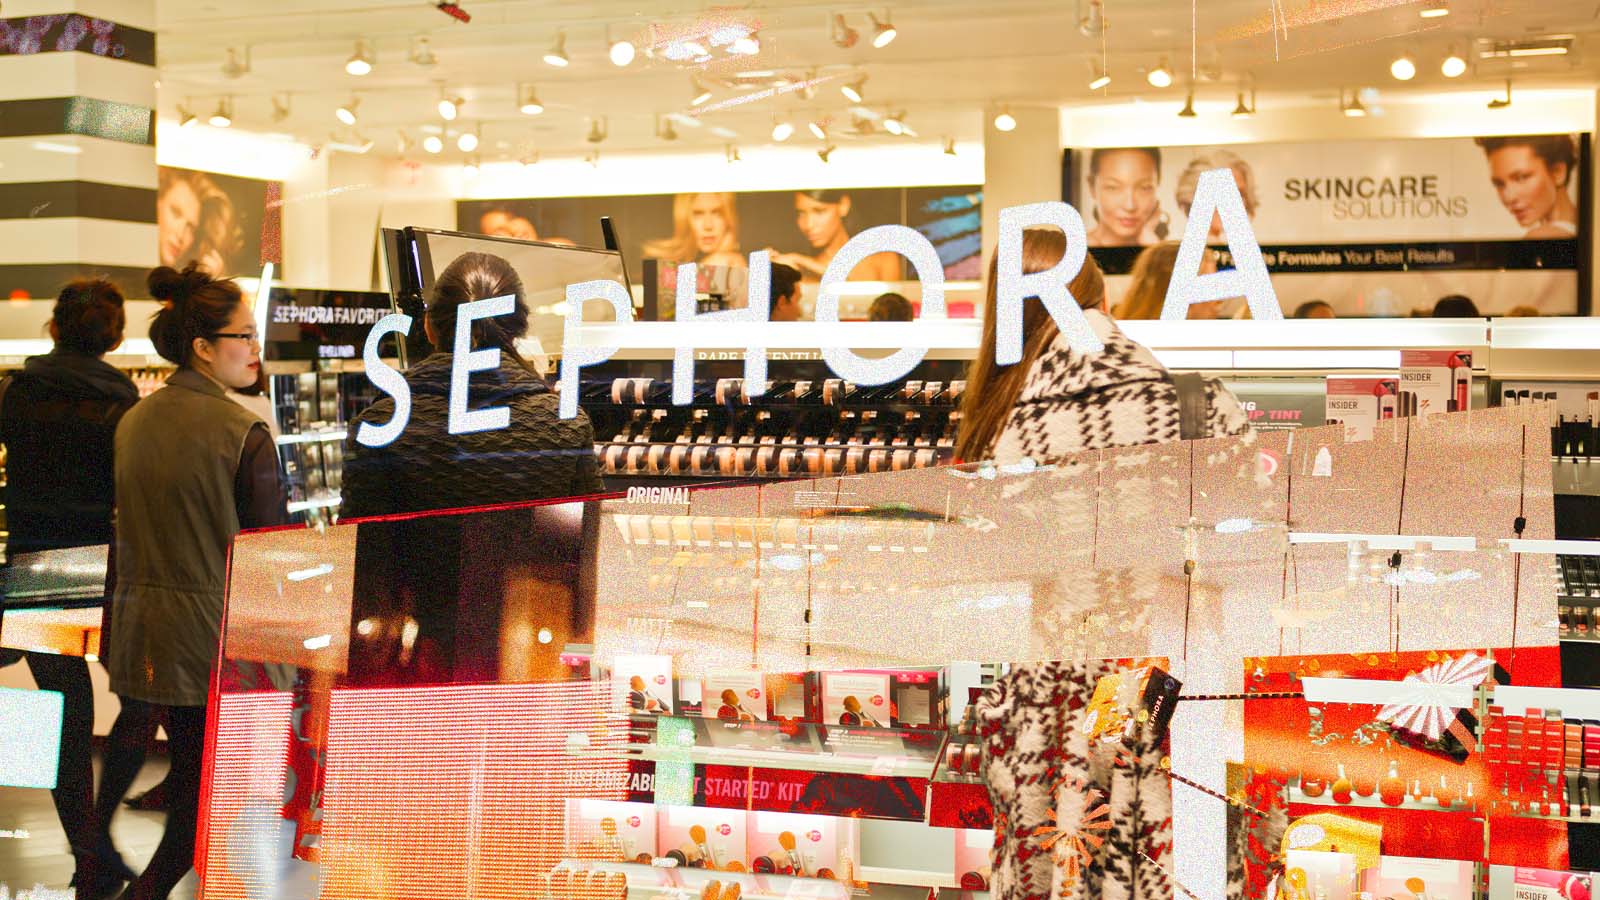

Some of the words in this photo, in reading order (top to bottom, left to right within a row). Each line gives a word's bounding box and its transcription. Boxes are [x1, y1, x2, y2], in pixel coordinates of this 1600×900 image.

[1284, 175, 1438, 200] SKINCARE
[1333, 197, 1469, 220] SOLUTIONS
[1278, 250, 1341, 266] Formulas
[1343, 249, 1372, 264] Your
[1375, 248, 1403, 264] Best
[1408, 247, 1455, 264] Results
[273, 305, 333, 324] SEPHORA
[355, 167, 1284, 449] SEPHORA
[1401, 373, 1432, 381] INSIDER
[1328, 401, 1358, 409] INSIDER
[1270, 410, 1303, 420] TINT
[627, 486, 691, 505] ORIGINAL
[778, 782, 803, 802] KIT
[1516, 891, 1548, 900] INSIDER
